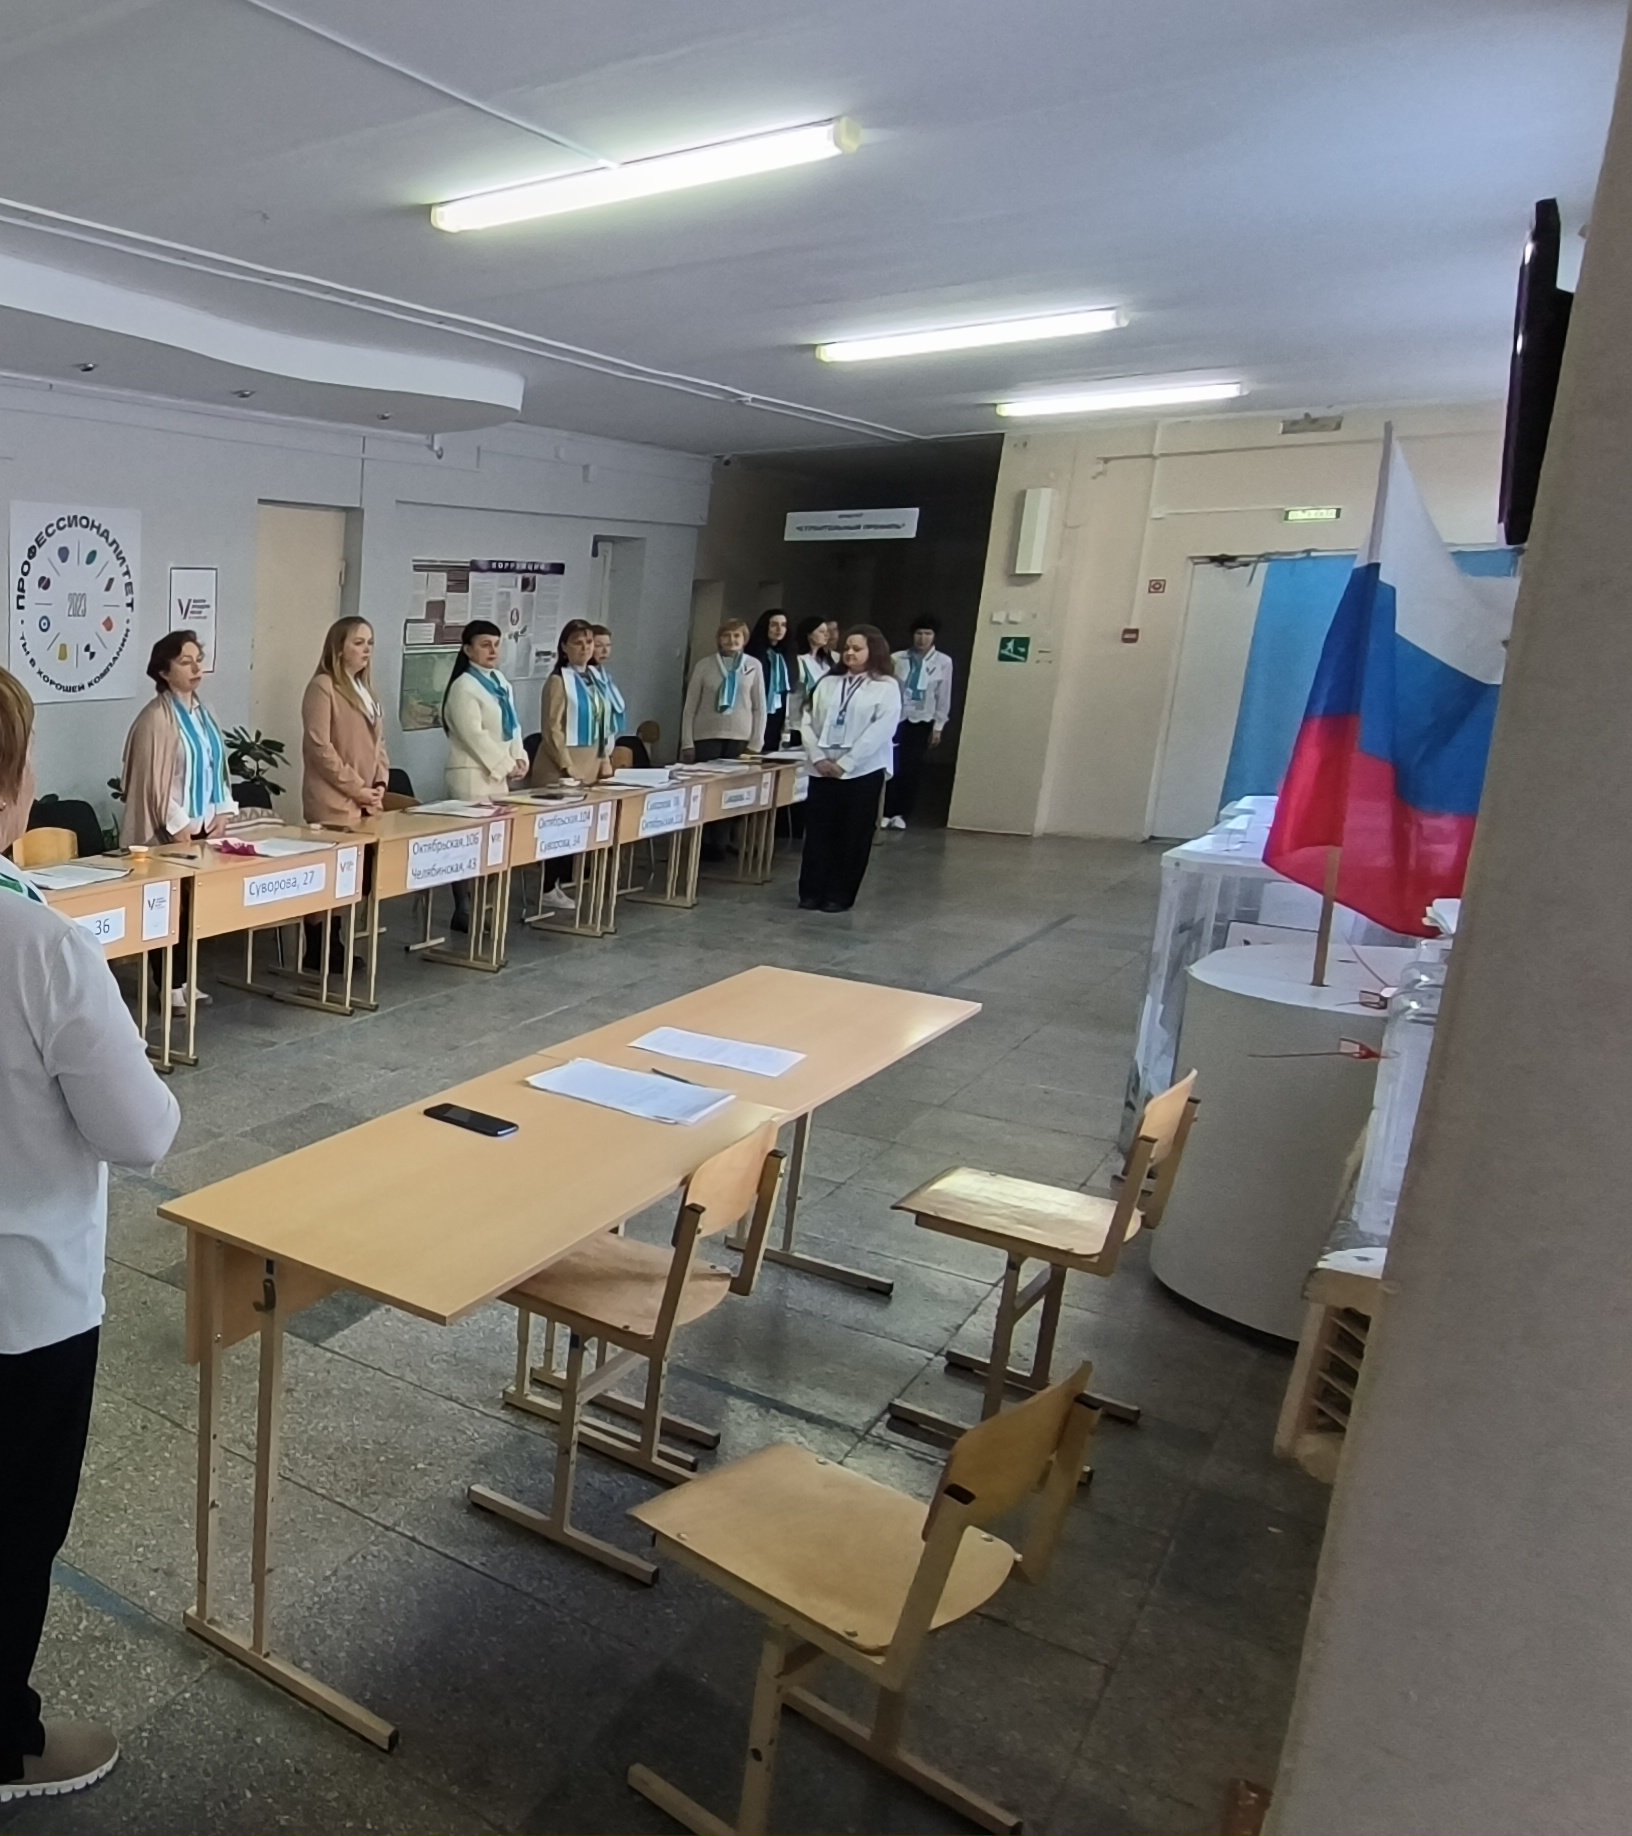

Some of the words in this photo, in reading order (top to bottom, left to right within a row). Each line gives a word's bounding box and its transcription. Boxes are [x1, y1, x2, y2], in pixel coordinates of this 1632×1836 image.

[16, 515, 134, 612] ПРОФЕССИОНАЛИТЕТ
[19, 631, 30, 656] ТЫ
[36, 668, 85, 693] ХОРОШЕЙ
[88, 628, 131, 688] КОМПАНИИ
[249, 876, 300, 898] Суворова,
[303, 870, 315, 886] 27
[95, 918, 110, 936] 36
